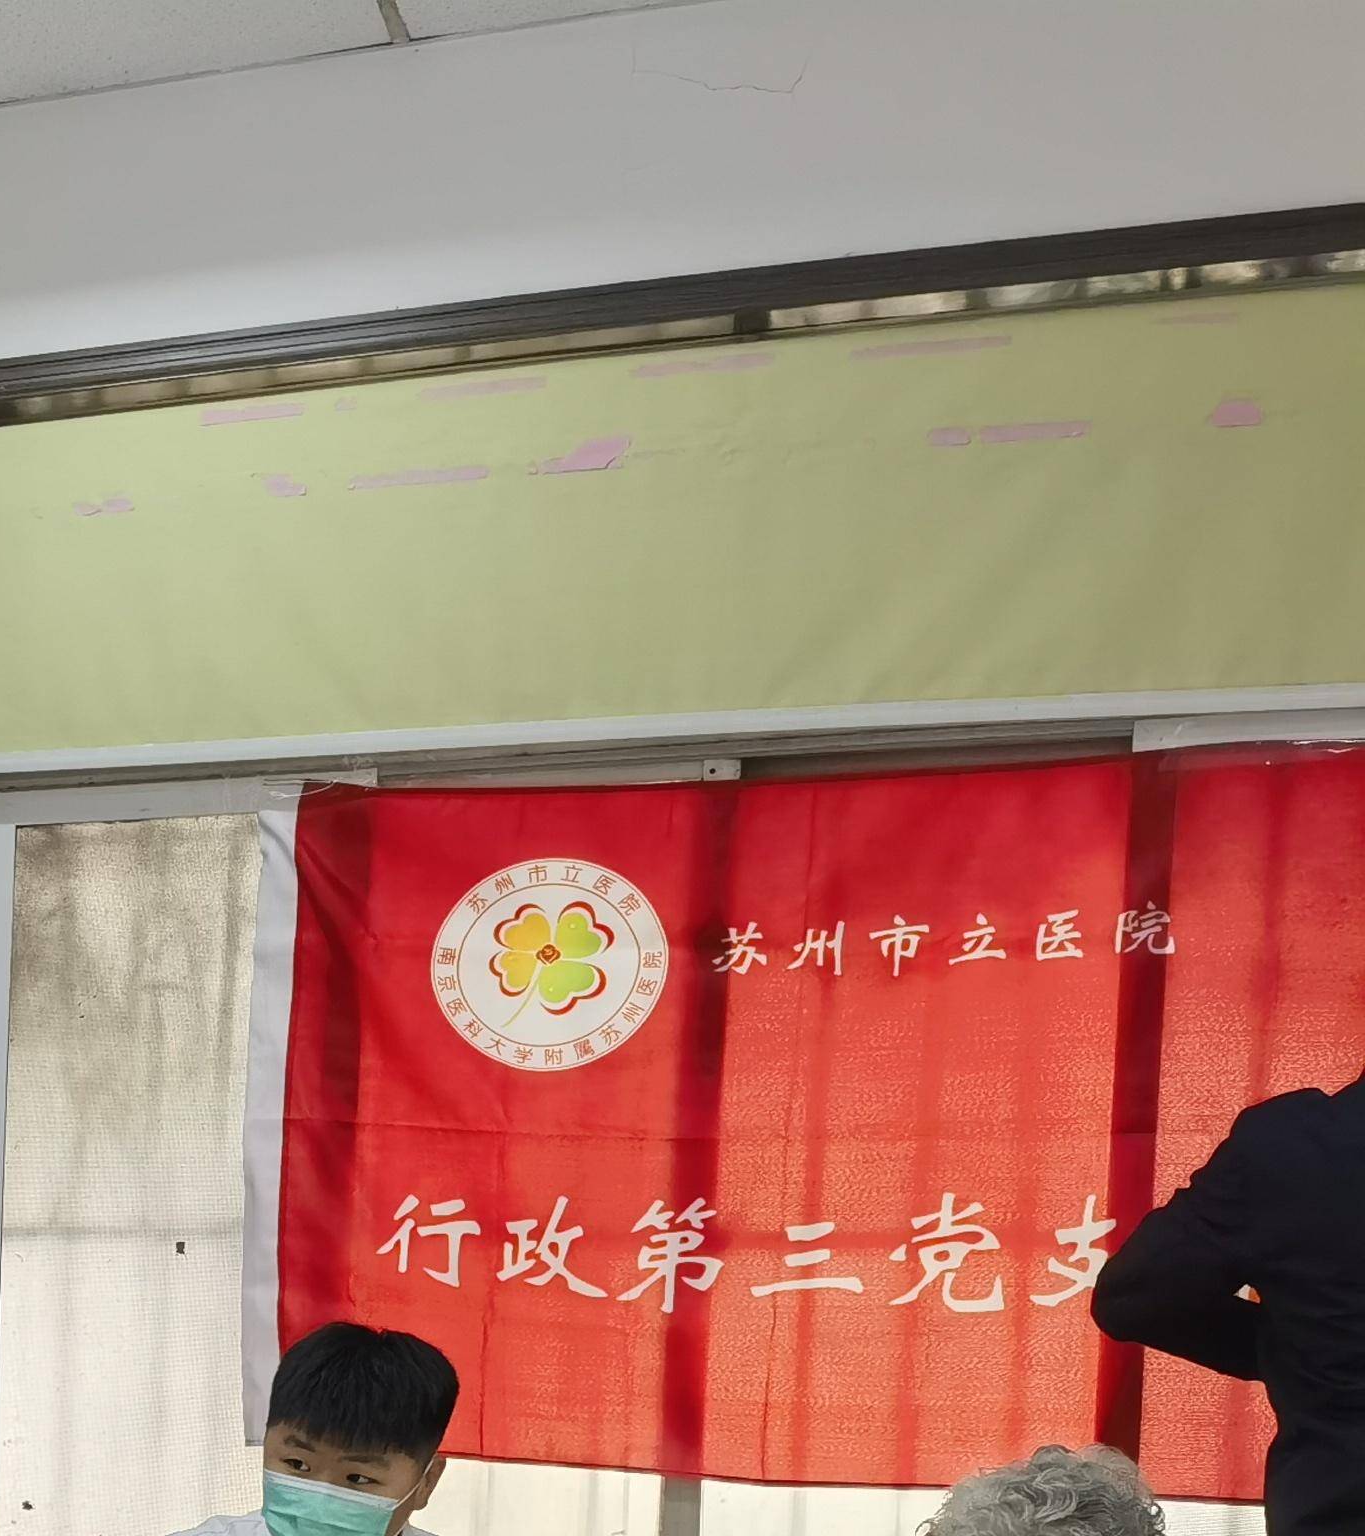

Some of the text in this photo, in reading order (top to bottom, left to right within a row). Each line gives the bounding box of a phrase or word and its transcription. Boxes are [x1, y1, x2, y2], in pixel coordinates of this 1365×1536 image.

[465, 864, 642, 917] 苏州市立医院
[711, 901, 1176, 978] 苏州市立医院
[436, 946, 664, 1067] 南京医科大学附属苏州医院
[377, 1191, 1117, 1314] 行政第三党支
